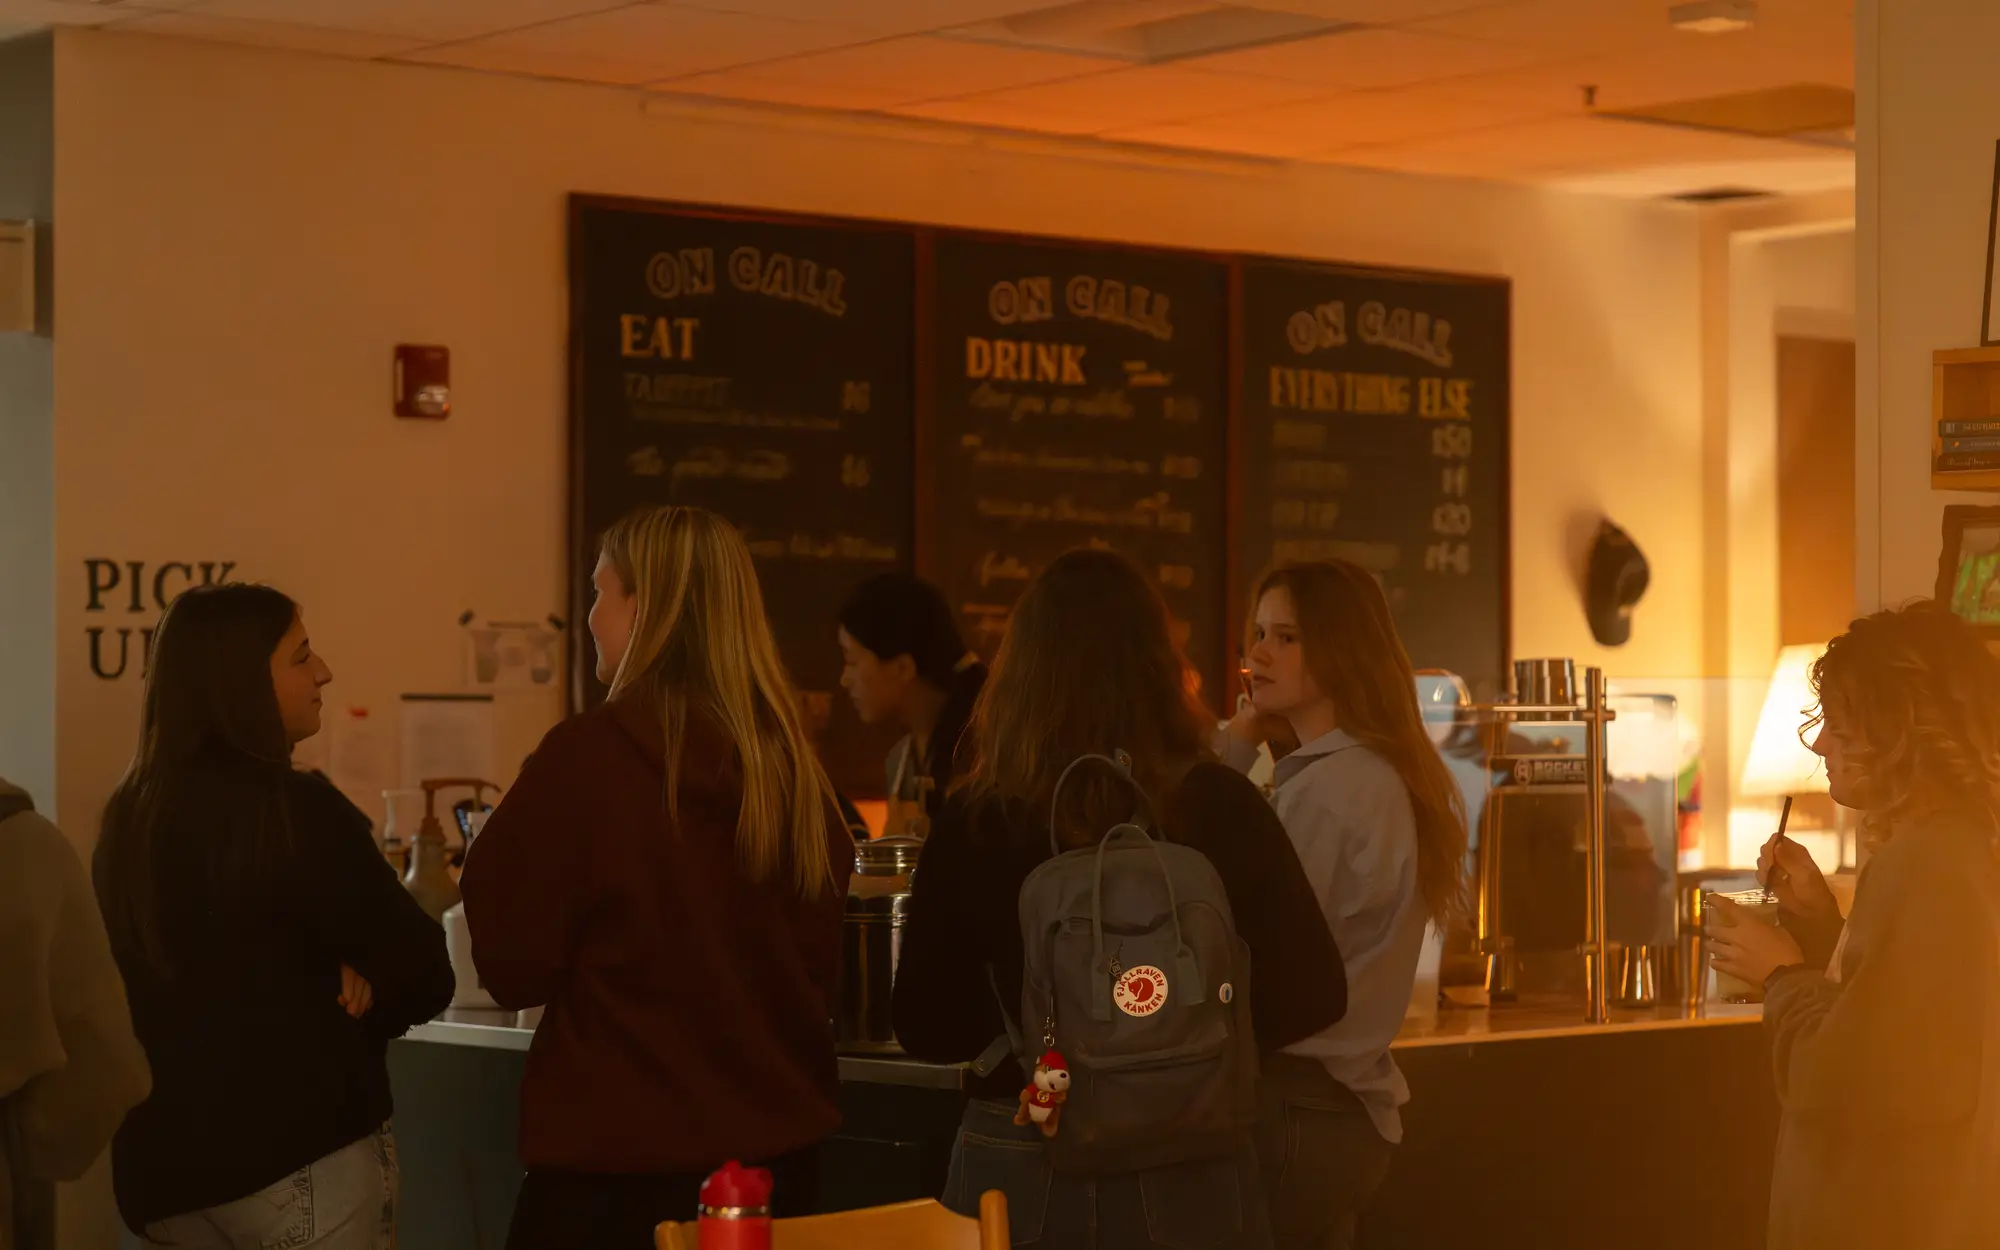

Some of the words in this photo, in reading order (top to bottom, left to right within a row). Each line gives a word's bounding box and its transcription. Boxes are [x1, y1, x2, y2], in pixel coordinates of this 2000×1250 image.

[646, 248, 715, 298] ON
[728, 246, 847, 316] CALL
[988, 276, 1052, 325] ON
[1066, 274, 1172, 341] CALL
[620, 314, 699, 360] EAT
[966, 336, 1086, 385] DRINK
[1286, 300, 1346, 355] ON
[1357, 300, 1453, 368] CALL
